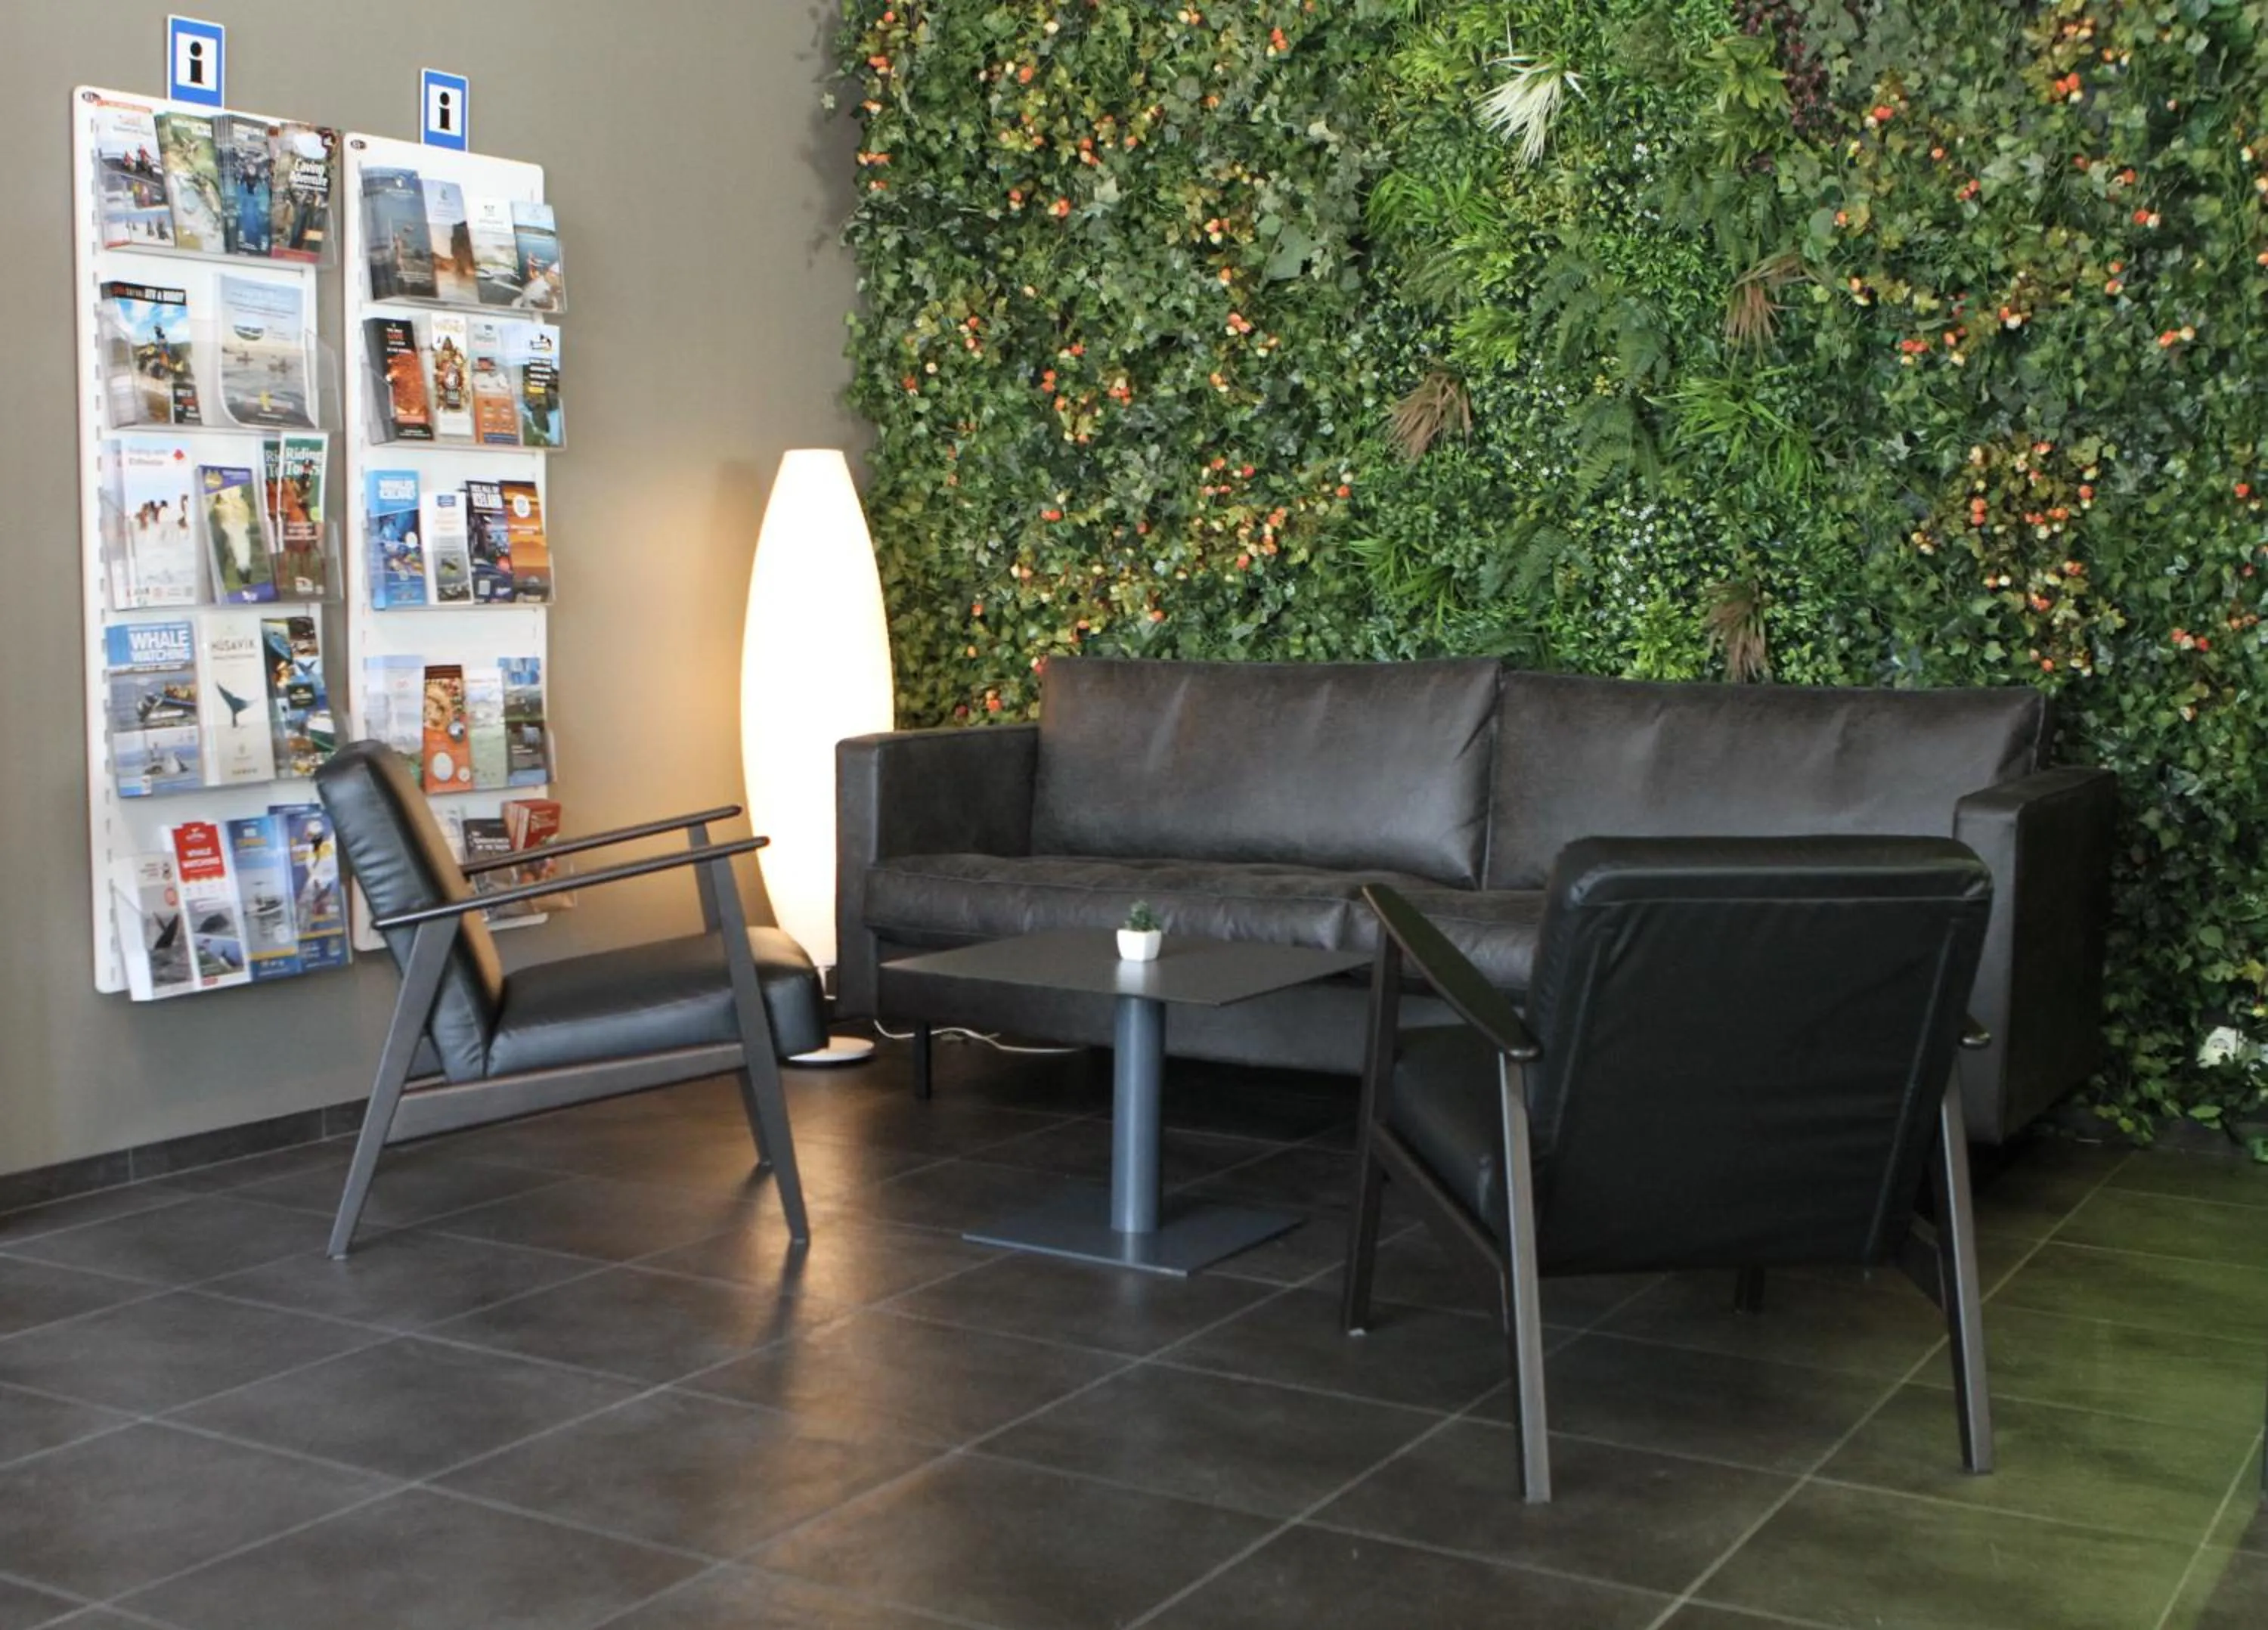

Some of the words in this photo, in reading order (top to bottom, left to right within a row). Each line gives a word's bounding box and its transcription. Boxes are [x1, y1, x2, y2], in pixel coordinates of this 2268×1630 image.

[285, 447, 324, 466] Riding
[129, 630, 189, 650] WHALE
[132, 647, 191, 663] WATCHING
